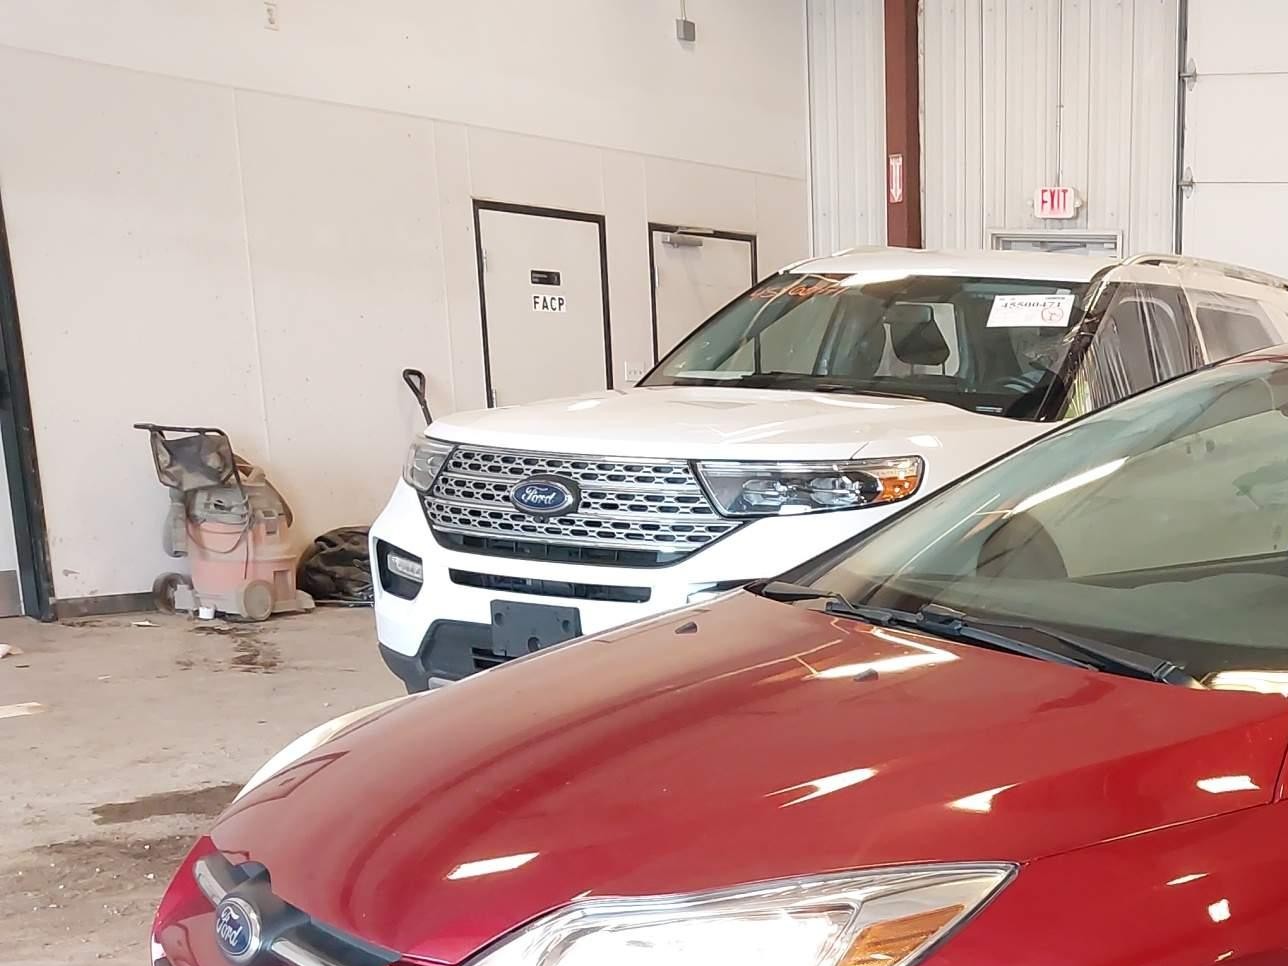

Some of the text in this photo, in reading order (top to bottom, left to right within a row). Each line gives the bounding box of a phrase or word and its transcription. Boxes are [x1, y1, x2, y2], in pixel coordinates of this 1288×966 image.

[1041, 189, 1069, 211] EXIT
[533, 296, 565, 311] FACP
[521, 485, 556, 505] Ford
[216, 906, 243, 947] Ford
